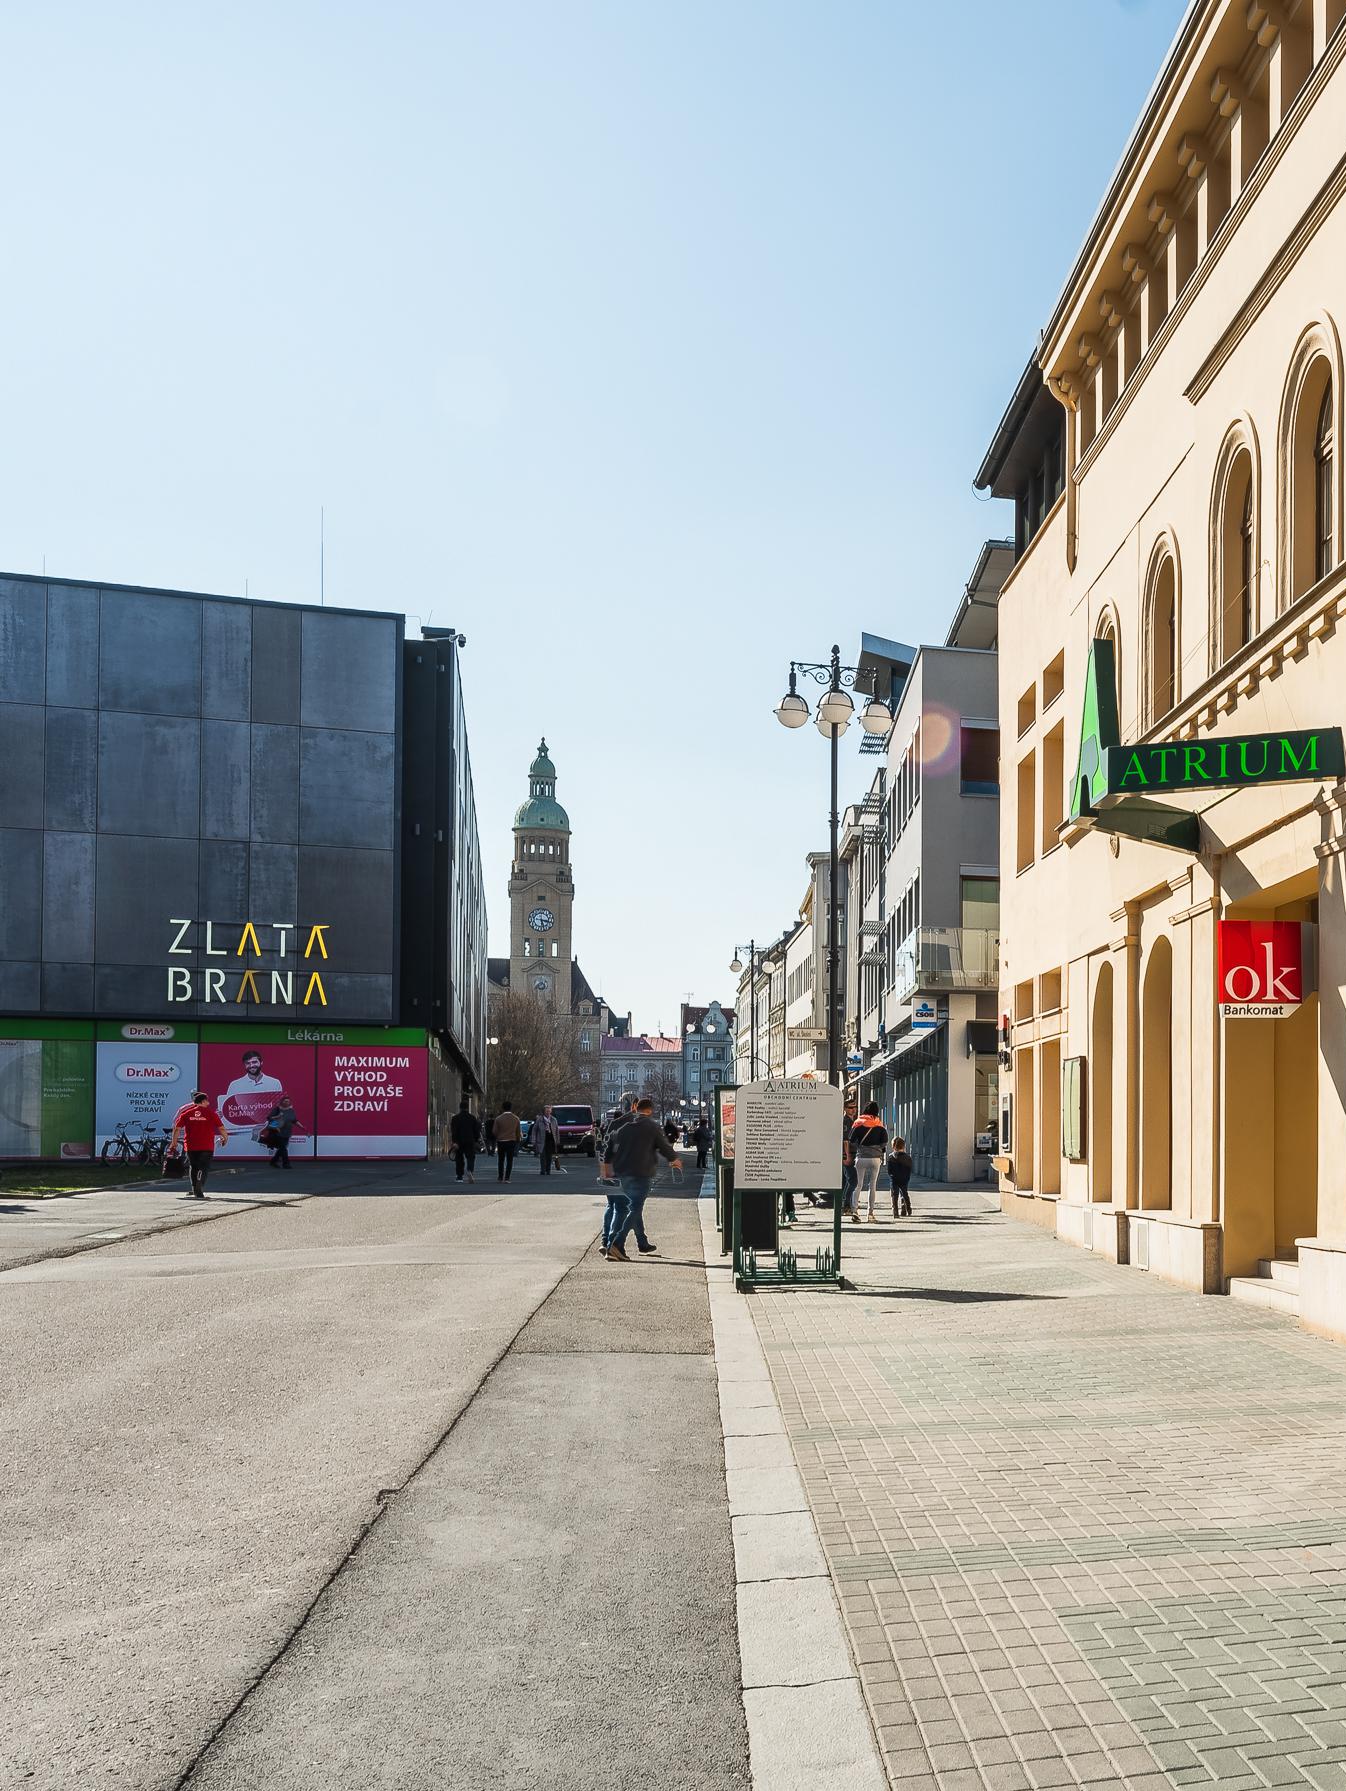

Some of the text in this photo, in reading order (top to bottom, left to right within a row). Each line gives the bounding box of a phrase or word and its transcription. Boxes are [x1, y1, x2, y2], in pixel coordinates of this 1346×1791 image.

[1119, 735, 1321, 786] ATRIUM
[1224, 941, 1301, 1001] ok
[1223, 1004, 1284, 1016] Bankomat
[287, 1029, 345, 1042] Lékárna
[334, 1056, 410, 1068] MAXIMUM
[334, 1068, 388, 1082] VÝHOD
[334, 1084, 404, 1097] PRO VAŠE
[777, 1081, 817, 1090] ATRIUM
[126, 1091, 170, 1100] NÍZKÉ CENY
[146, 1099, 167, 1107] VAŠE
[228, 1102, 274, 1113] Karta výhod
[333, 1099, 389, 1112] ZDRAVÍ
[133, 1105, 163, 1114] ZDRAVÍ
[228, 1110, 256, 1119] Dr.Max
